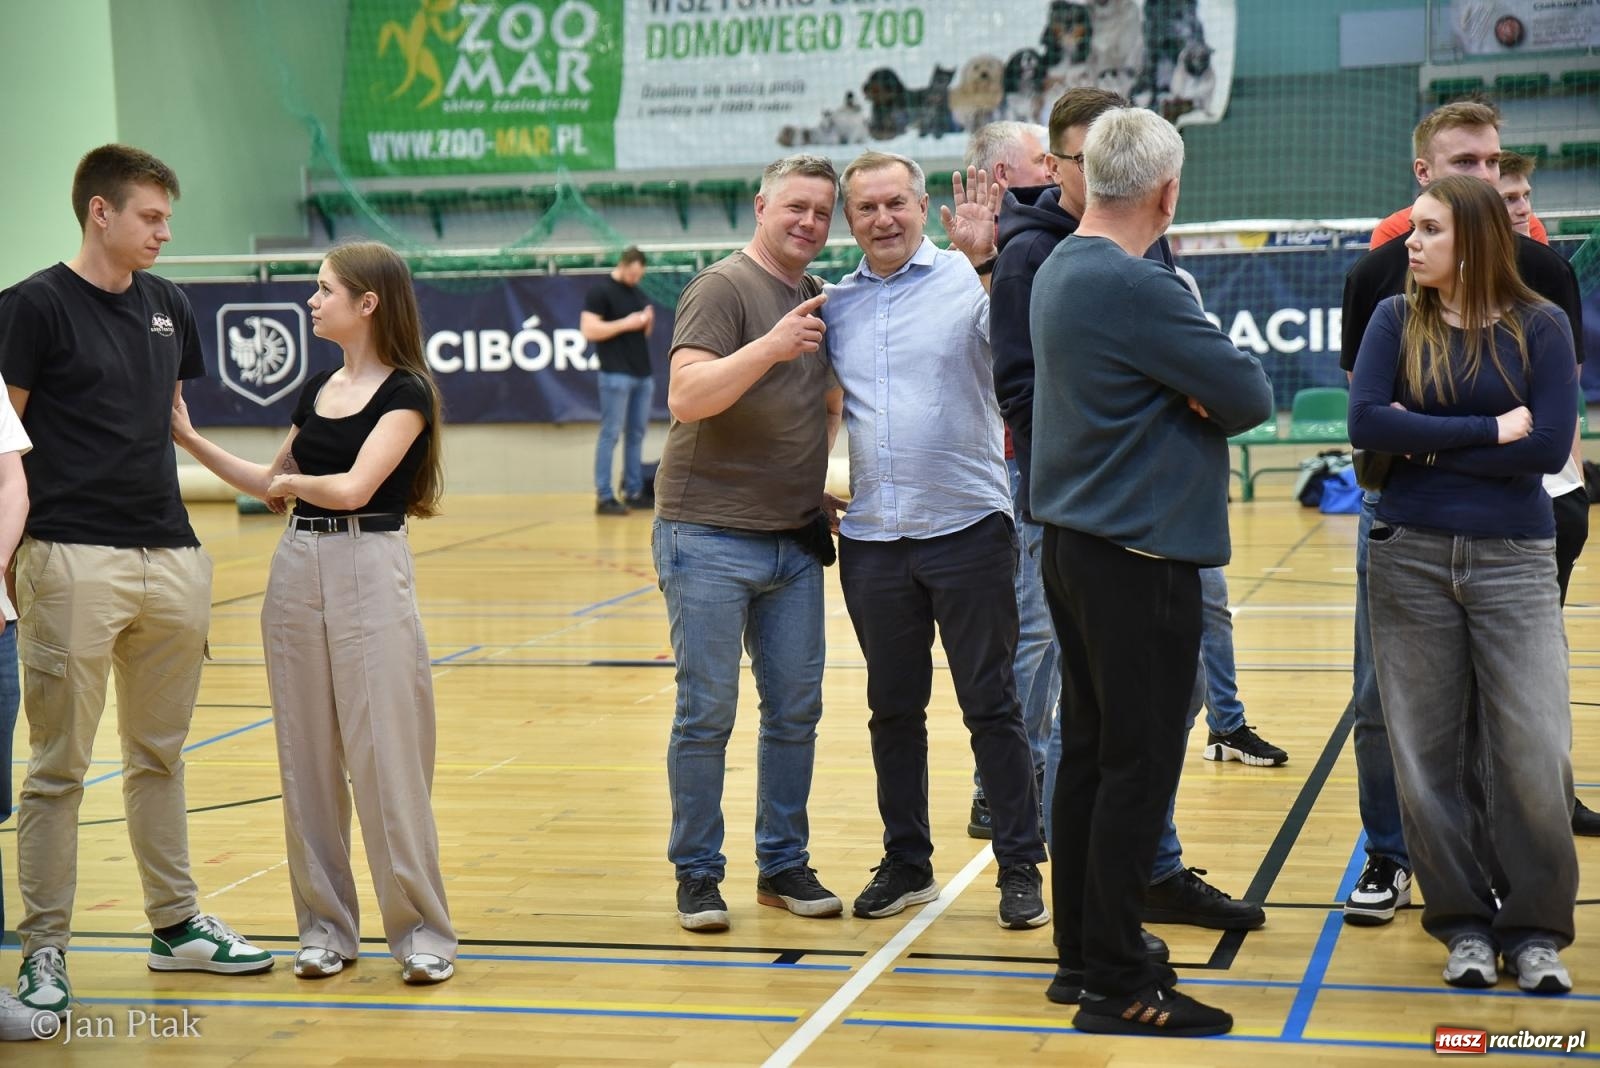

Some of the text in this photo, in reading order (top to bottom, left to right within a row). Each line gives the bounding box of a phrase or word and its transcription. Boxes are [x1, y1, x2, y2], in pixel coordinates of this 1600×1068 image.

[457, 0, 600, 50] ZOO
[645, 8, 925, 59] DOMOWEGO ZOO
[444, 51, 593, 96] MAR
[367, 123, 588, 163] WWW.ZOO-MAR.PL
[426, 314, 601, 373] CIBÓR
[1205, 307, 1342, 354] ACI
